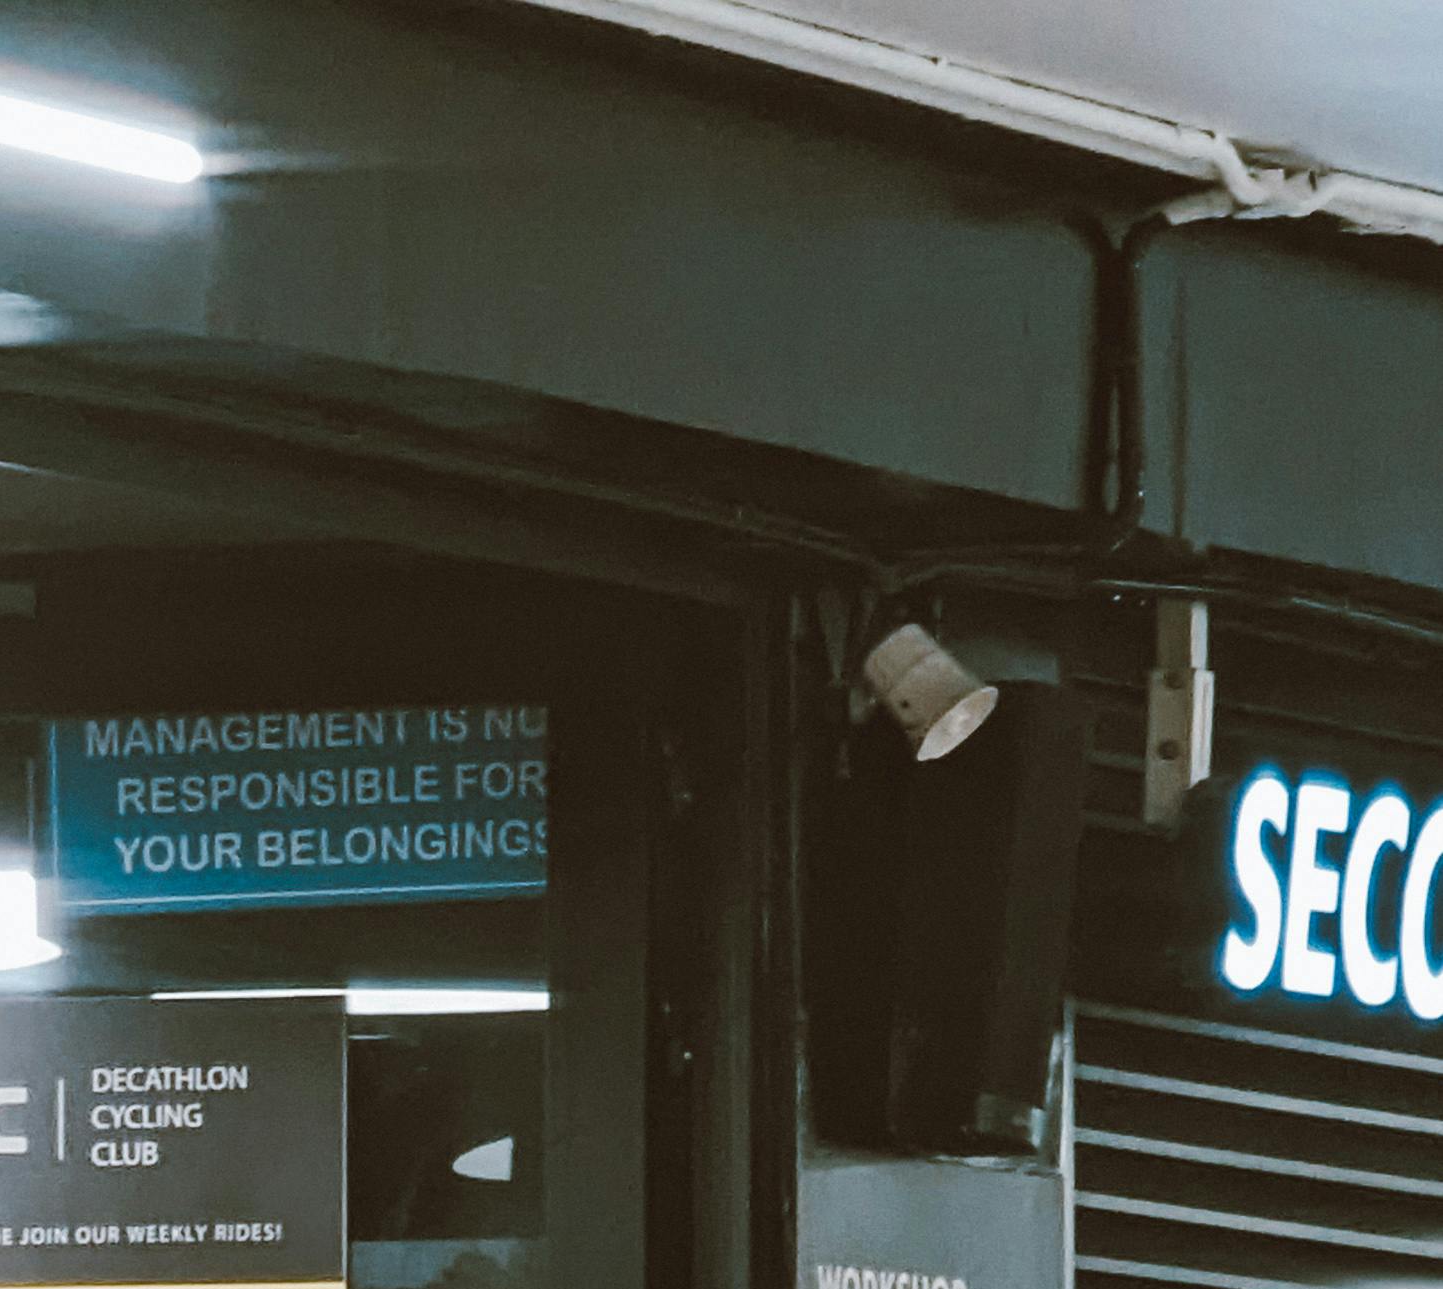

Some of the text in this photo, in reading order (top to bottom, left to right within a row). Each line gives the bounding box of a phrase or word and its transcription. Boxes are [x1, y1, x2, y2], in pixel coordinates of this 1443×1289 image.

[86, 711, 407, 757] MANAGEMENT
[428, 709, 468, 742] IS
[117, 760, 546, 815] RESPONSIBLE FOR
[114, 831, 242, 873] YOUR
[91, 1065, 249, 1093] DECATHLON
[90, 1103, 203, 1130] CYCLING
[90, 1141, 159, 1167] CLUB
[19, 1227, 68, 1246] JOIN
[75, 1226, 120, 1245] OUR
[125, 1225, 208, 1243] WEEKLY
[214, 1223, 282, 1242] RIDES!
